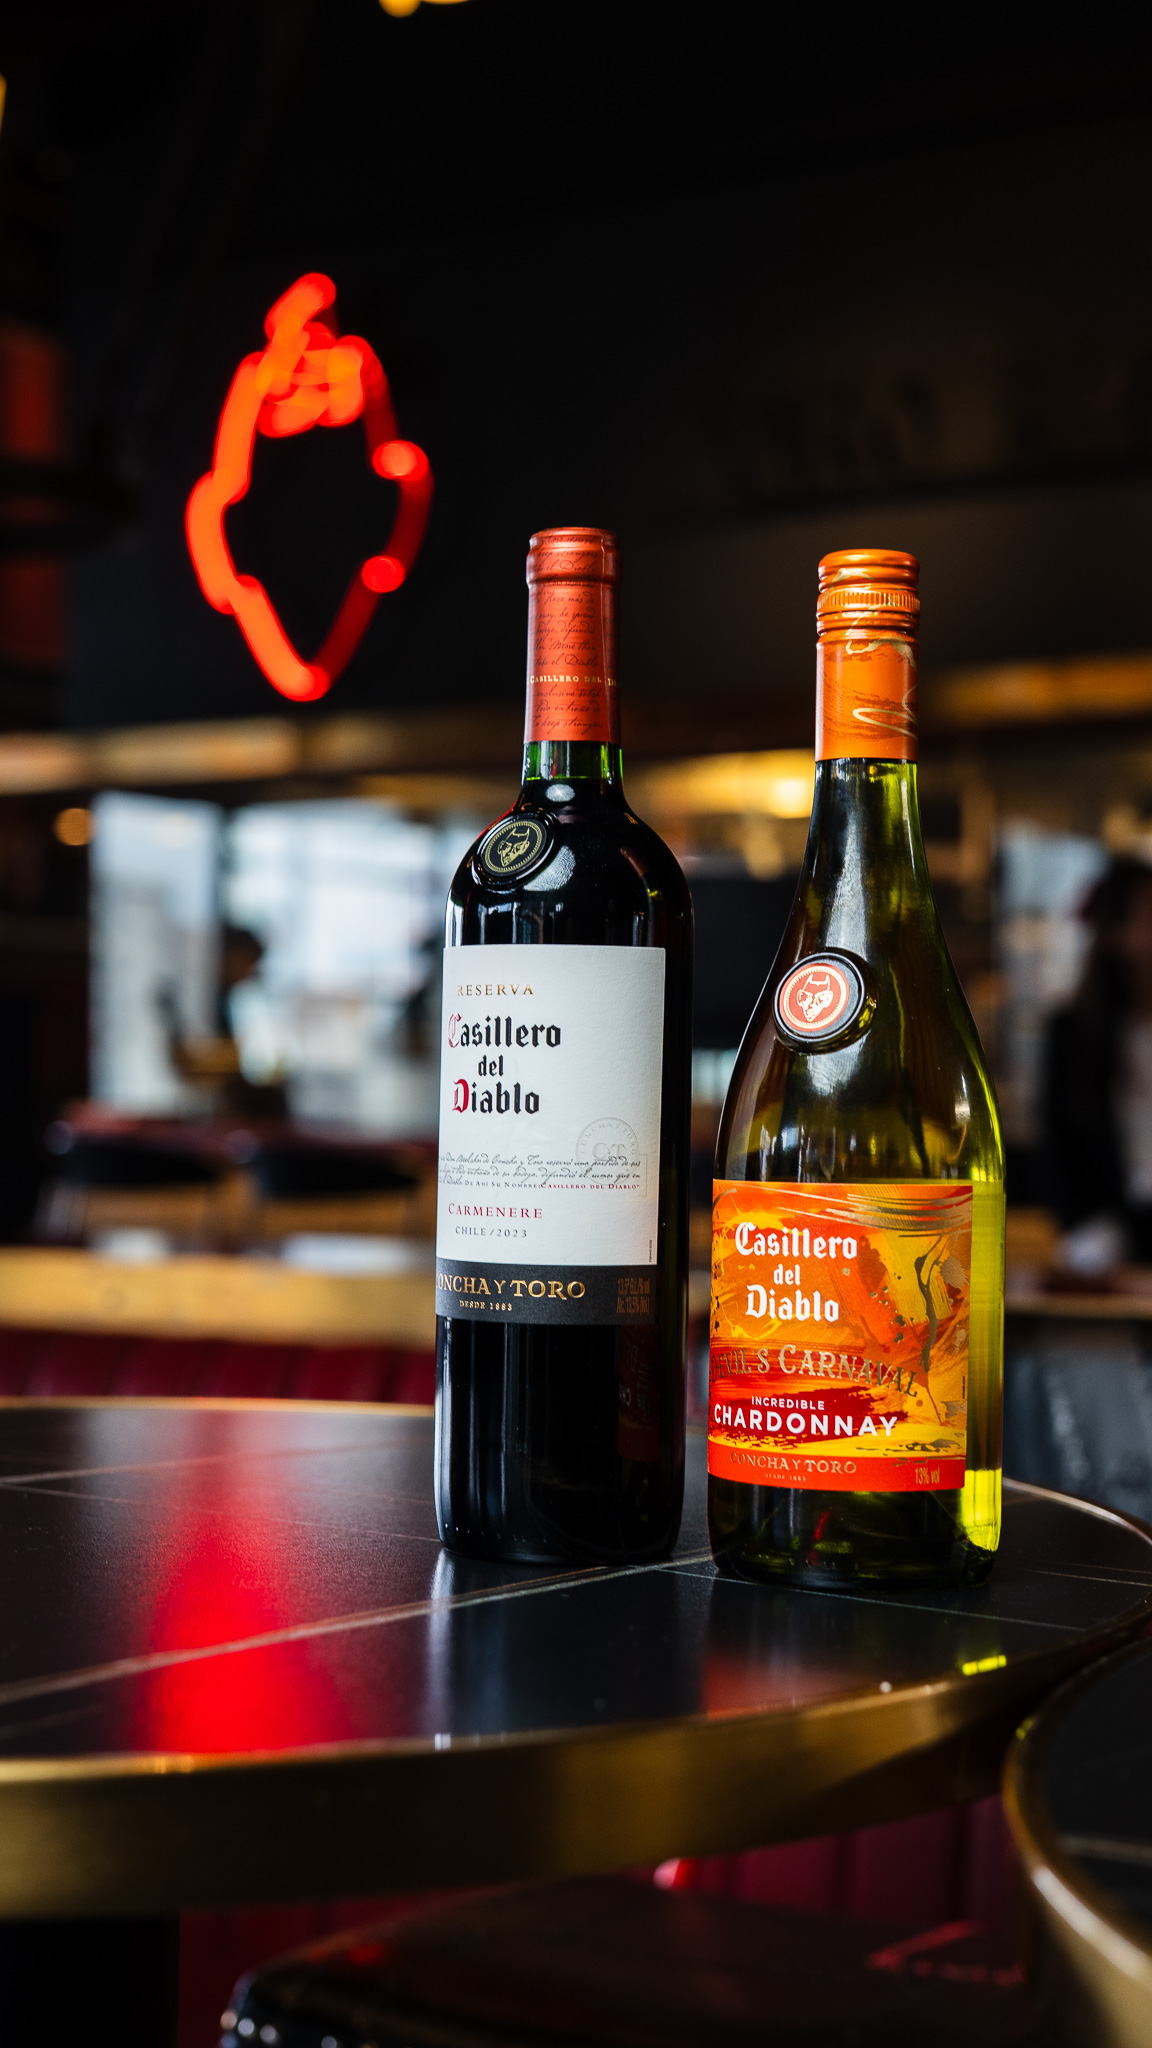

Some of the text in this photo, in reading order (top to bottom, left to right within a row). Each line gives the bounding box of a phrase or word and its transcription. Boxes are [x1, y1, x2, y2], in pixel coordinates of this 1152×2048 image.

[457, 984, 534, 996] RESERVA
[448, 1012, 561, 1048] Casillero
[478, 1055, 504, 1076] del
[452, 1078, 540, 1114] Diablo
[448, 1203, 543, 1219] CARMENERE
[735, 1221, 858, 1259] Casillero
[435, 1271, 586, 1300] ONCHA Y TORO
[773, 1264, 801, 1285] del
[459, 1299, 513, 1312] DESDE 1883
[745, 1284, 839, 1322] Diablo
[711, 1348, 770, 1384] DEVIL'S
[777, 1344, 918, 1397] CARNAVAL
[751, 1396, 825, 1411] INCREDIBLE
[714, 1403, 897, 1437] CHARDONNAY
[730, 1451, 857, 1475] CONCHA Y TORO
